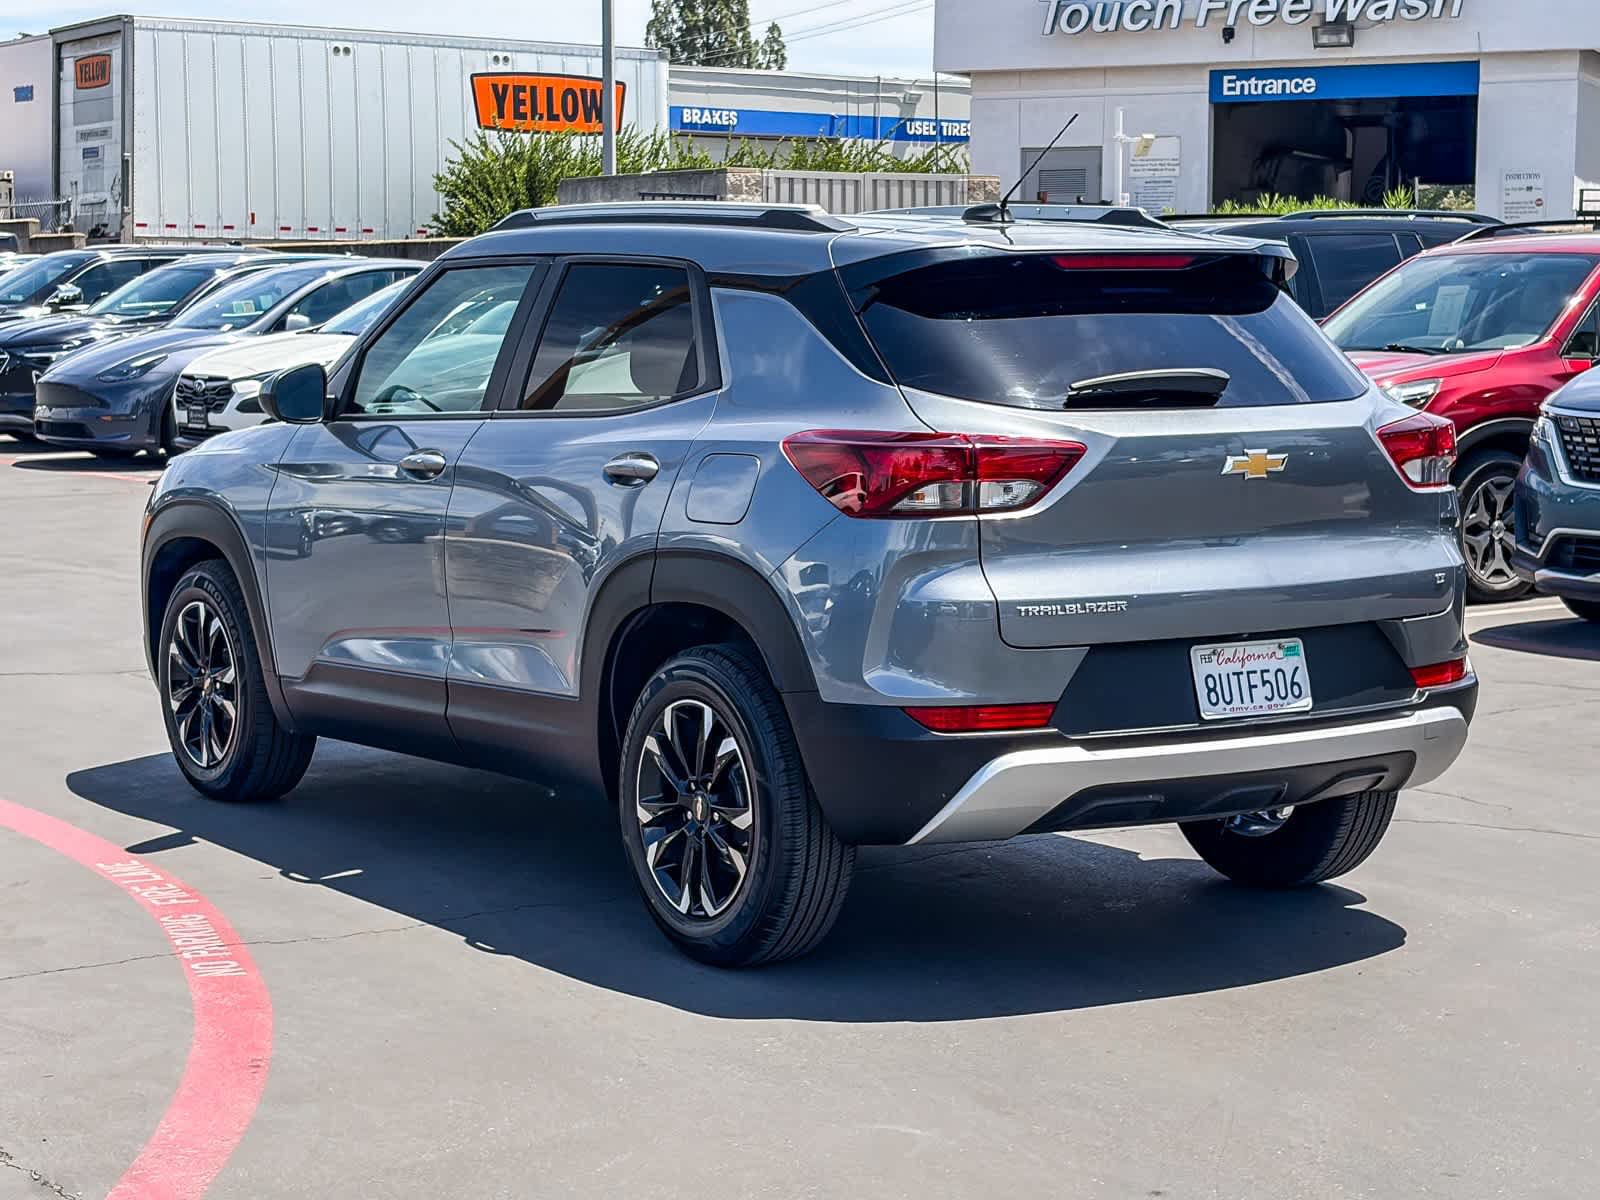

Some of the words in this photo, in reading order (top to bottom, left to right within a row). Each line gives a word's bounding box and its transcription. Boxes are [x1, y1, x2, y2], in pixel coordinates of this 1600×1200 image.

[1041, 0, 1182, 35] Touch
[1195, 0, 1311, 27] Free
[79, 60, 107, 83] YELLOW
[1222, 75, 1317, 96] Entrance
[491, 83, 604, 124] YELLOW
[682, 108, 738, 126] BRAKES
[906, 120, 937, 136] USED
[1016, 600, 1129, 617] TRAILBLAZER
[1216, 647, 1285, 668] California
[1204, 666, 1303, 707] 8UTF506
[131, 883, 200, 906] FIRE
[160, 913, 233, 960] PARKING
[190, 960, 248, 977] NO
